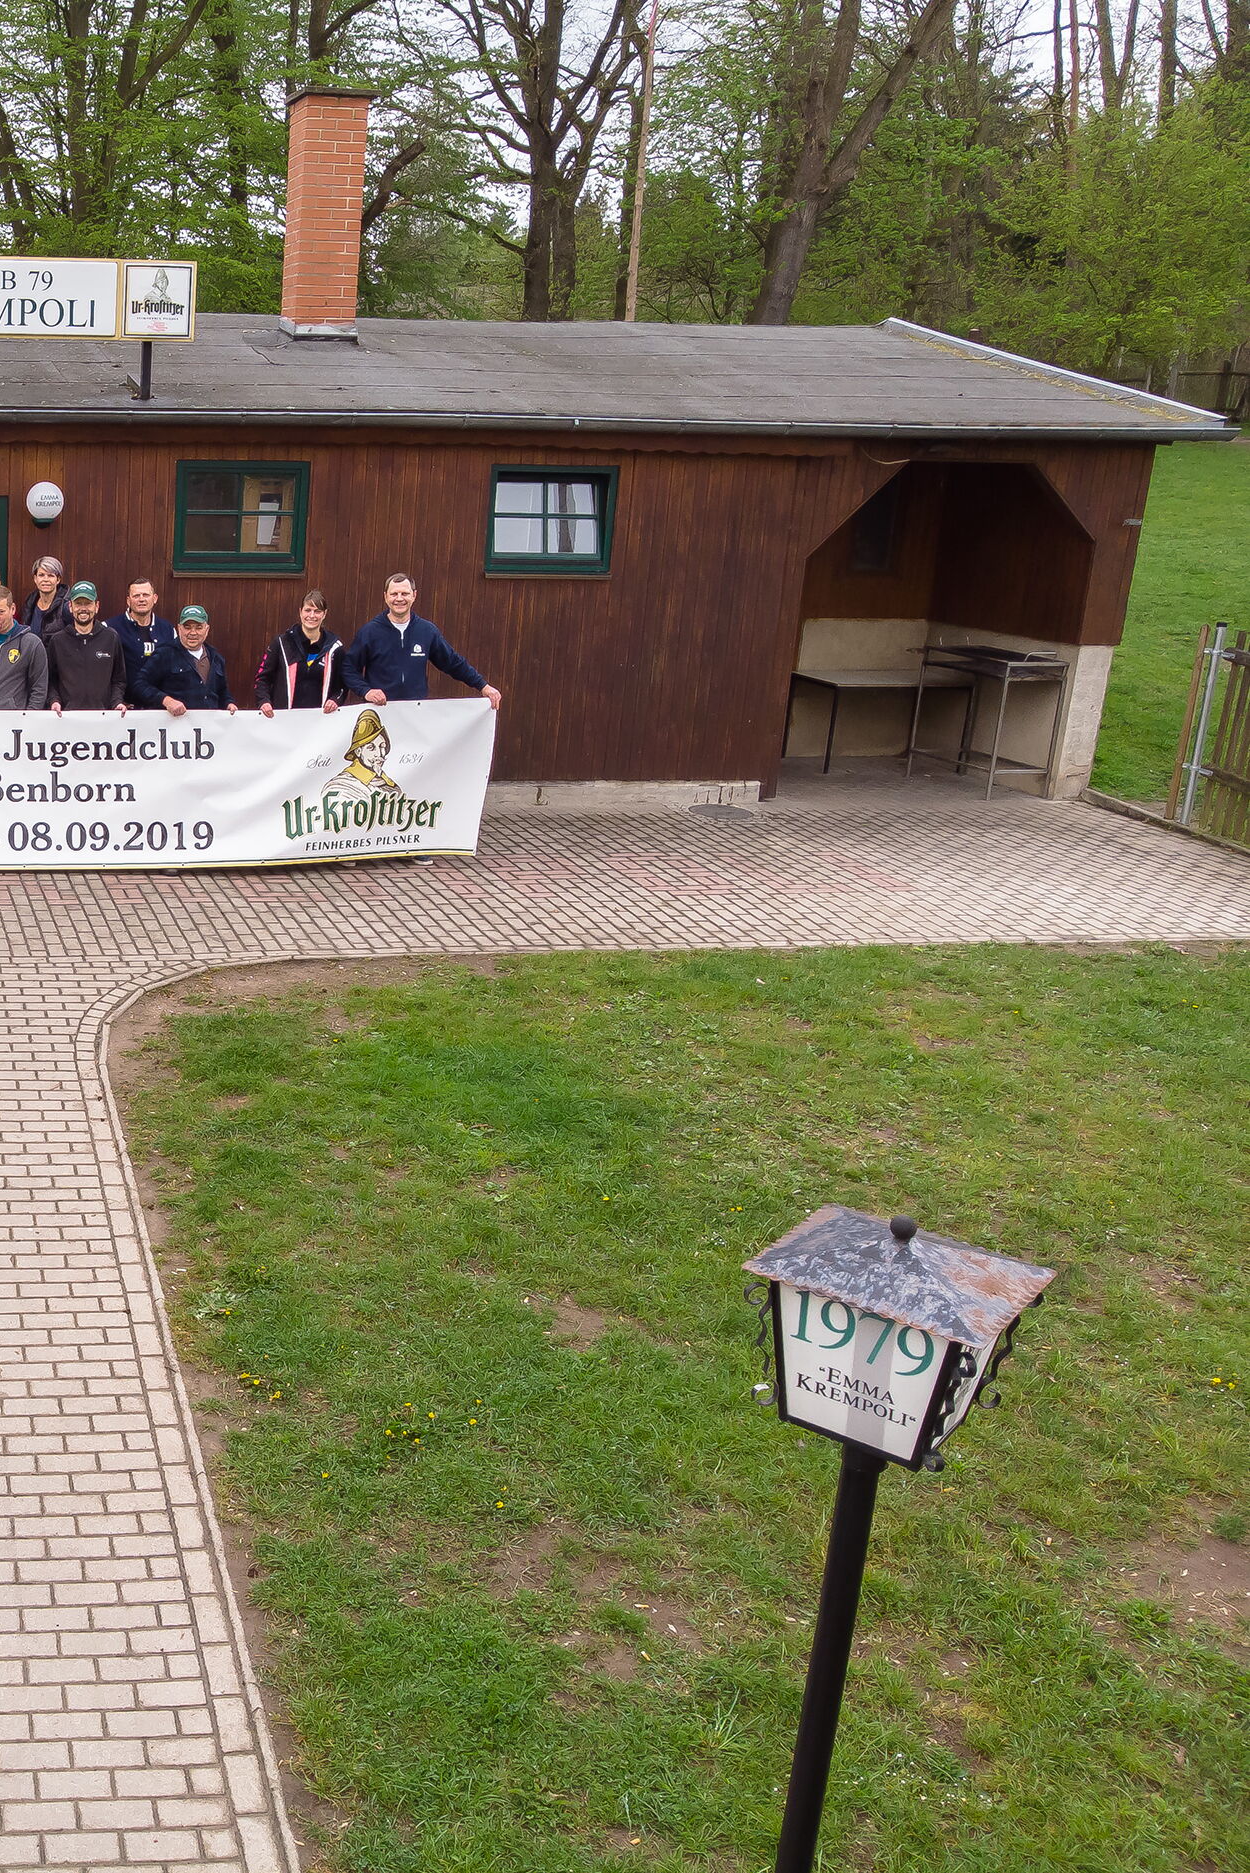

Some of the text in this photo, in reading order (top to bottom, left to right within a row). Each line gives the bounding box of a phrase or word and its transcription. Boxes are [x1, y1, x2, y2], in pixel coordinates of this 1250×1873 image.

[28, 270, 54, 291] 79
[3, 728, 215, 768] Jugendclub
[306, 755, 332, 769] Seit
[305, 834, 420, 852] FEINHERBES PILSNER
[790, 1290, 935, 1376] 1979
